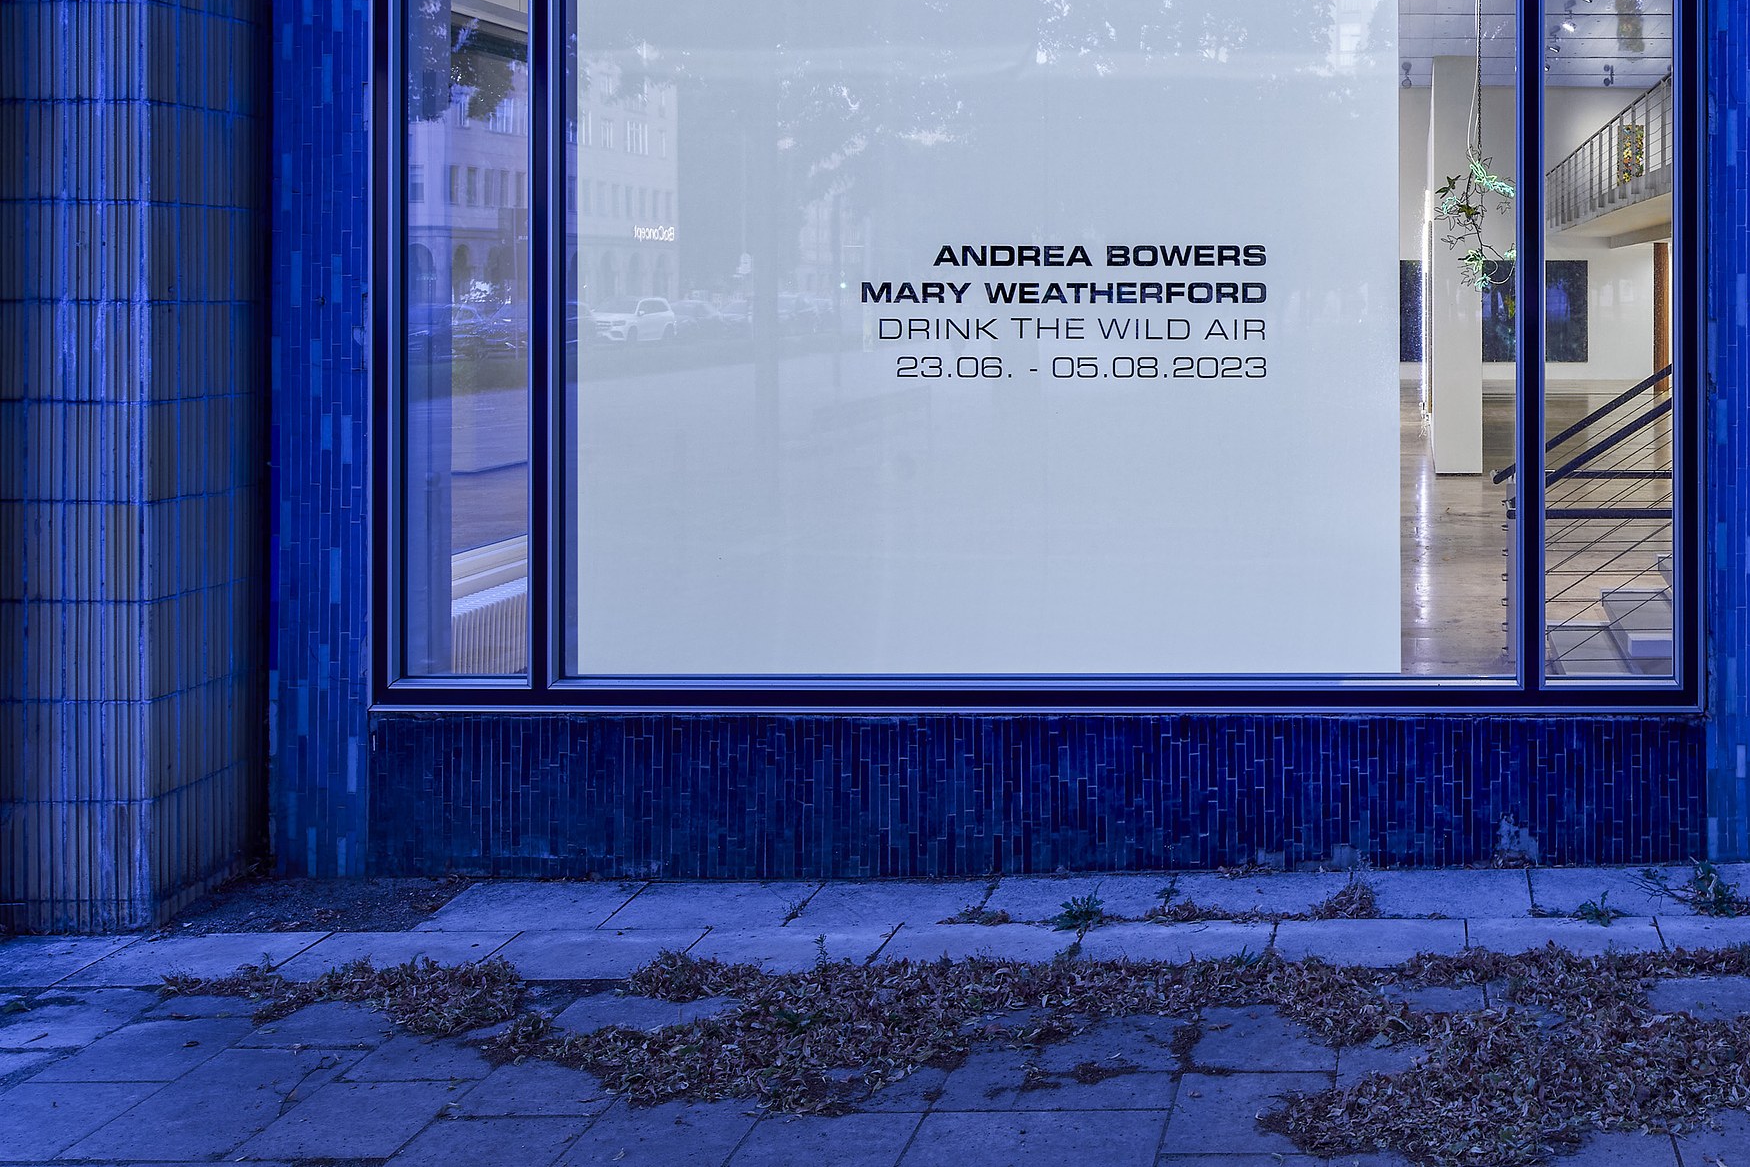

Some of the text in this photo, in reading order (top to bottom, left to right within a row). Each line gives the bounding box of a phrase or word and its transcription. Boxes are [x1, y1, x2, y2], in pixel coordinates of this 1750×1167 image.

[932, 244, 1267, 267] ANDREA BOWERS
[861, 281, 1267, 304] MARY WEATHERFORD
[878, 317, 1267, 341] DRINK THE WILD AIR
[896, 356, 1013, 379] 23.06.
[1052, 356, 1267, 379] 05.08.2023
